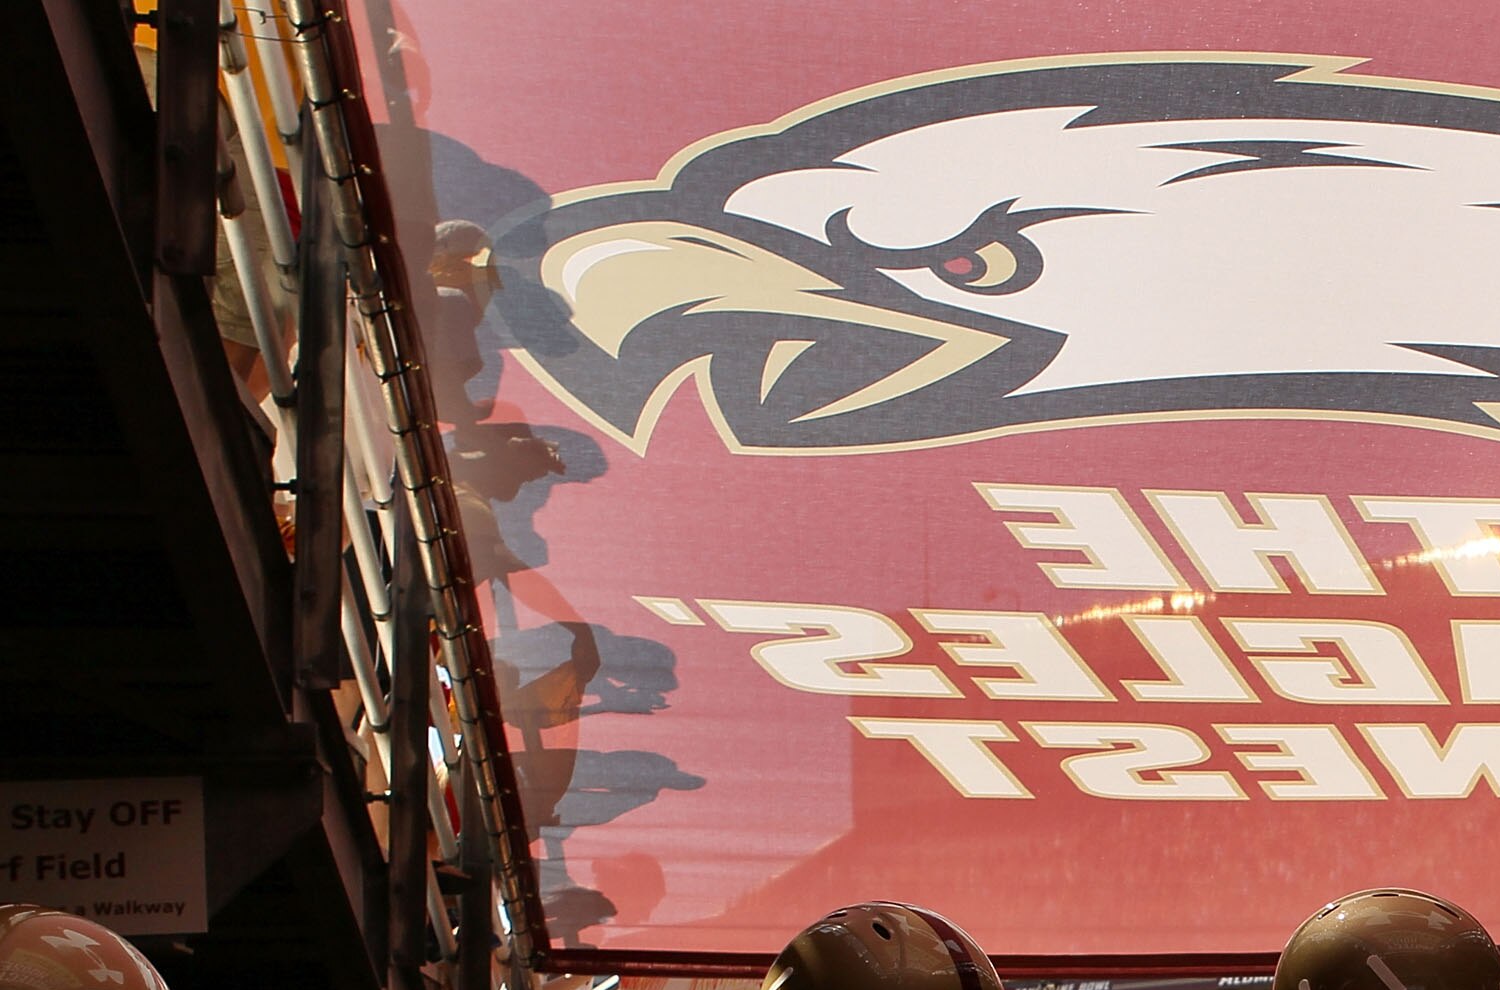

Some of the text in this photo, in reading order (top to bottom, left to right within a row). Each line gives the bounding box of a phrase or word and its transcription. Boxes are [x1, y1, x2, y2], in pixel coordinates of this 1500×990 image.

[11, 799, 182, 833] Stay OFF
[36, 852, 125, 880] Field
[93, 901, 185, 916] Walkway
